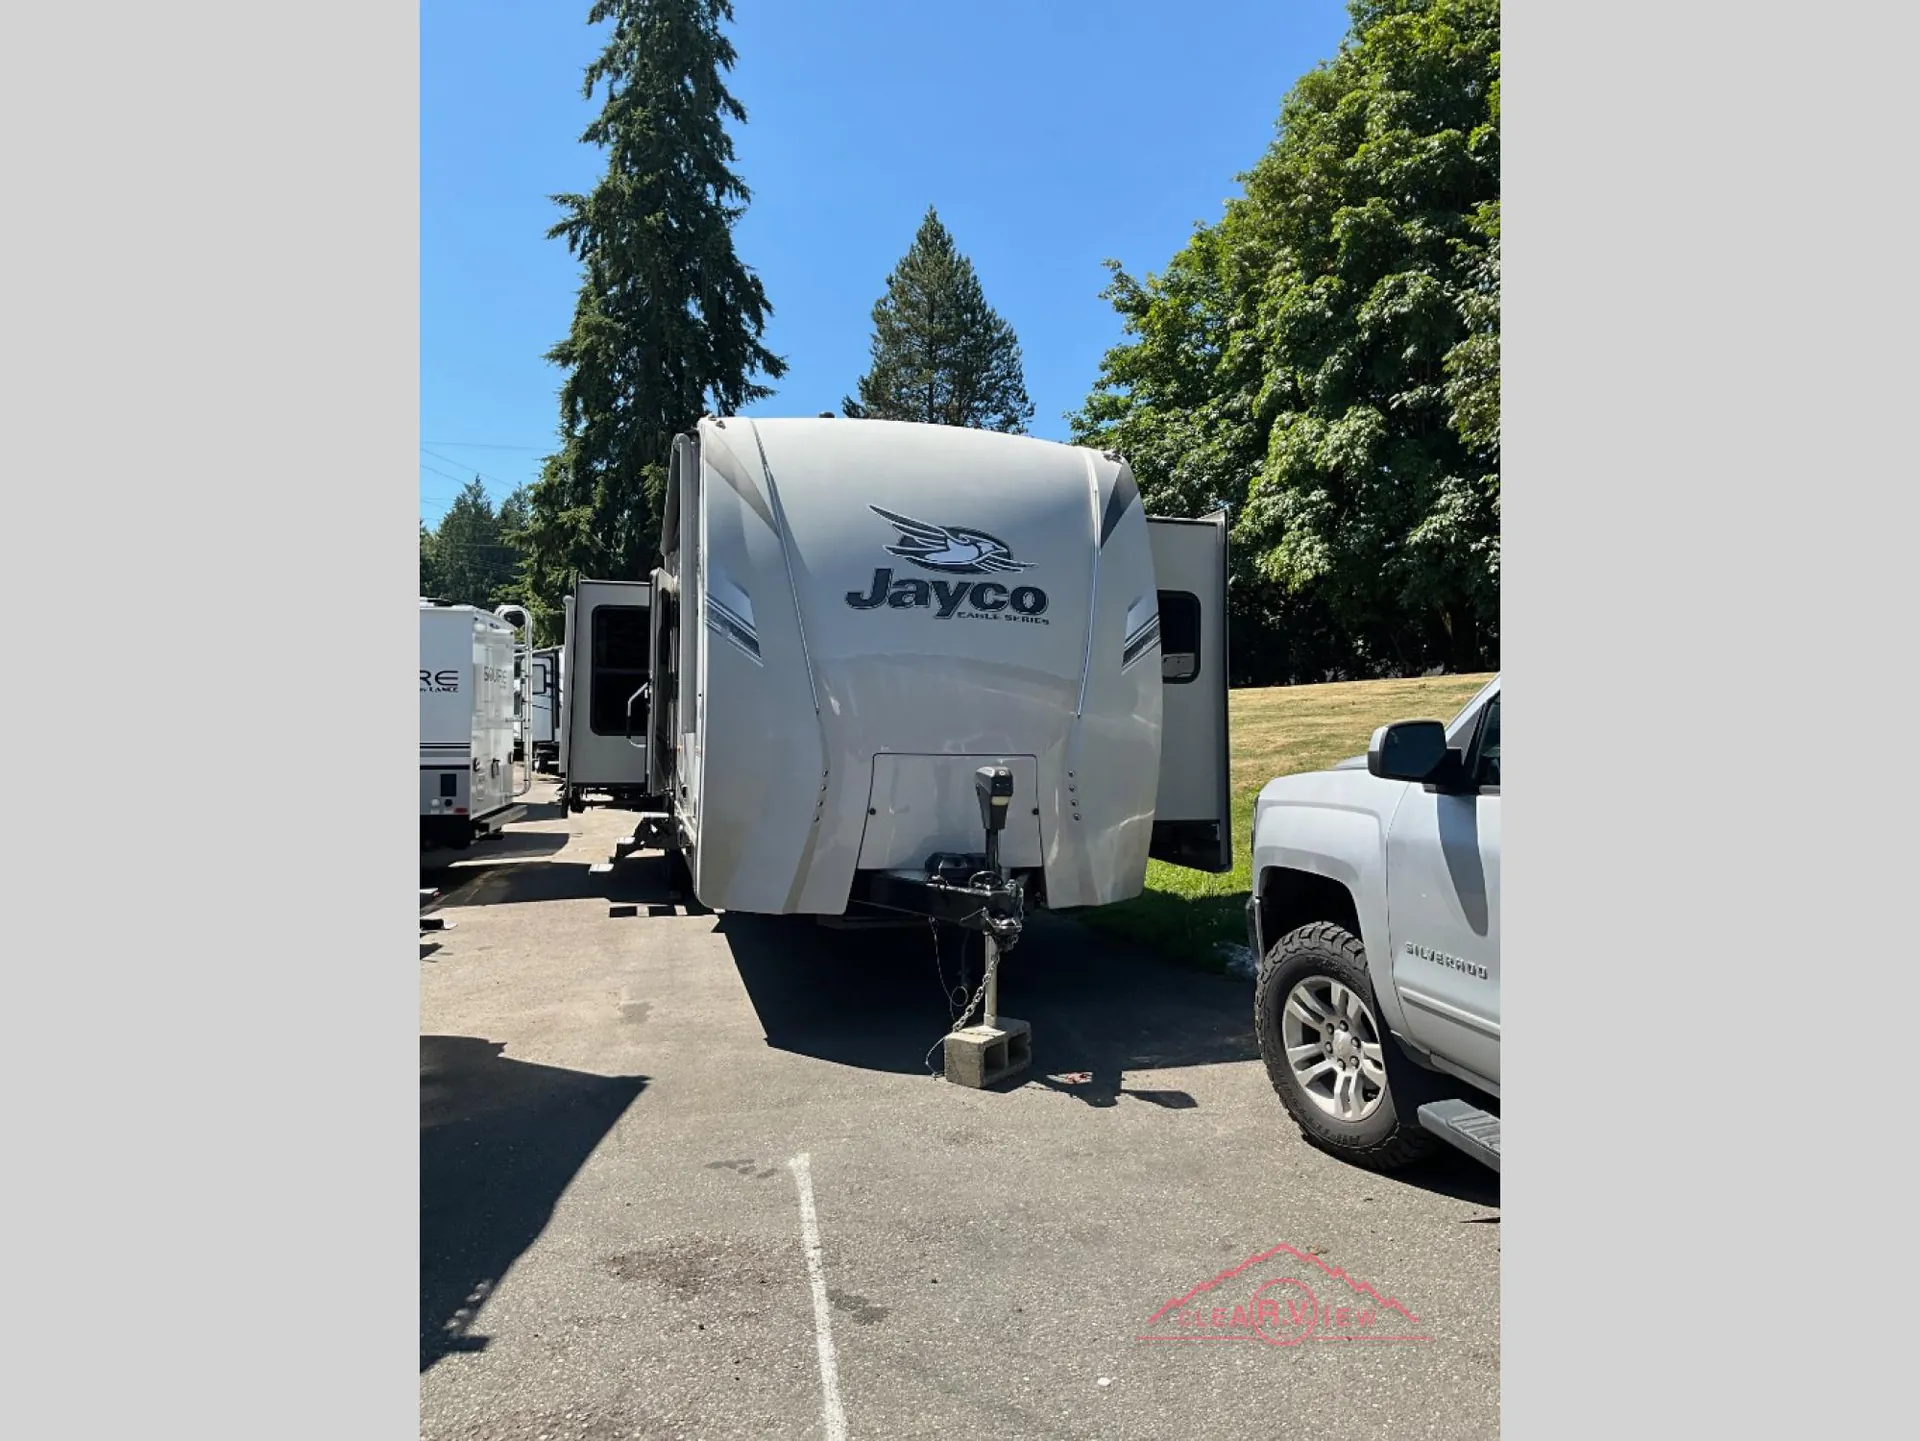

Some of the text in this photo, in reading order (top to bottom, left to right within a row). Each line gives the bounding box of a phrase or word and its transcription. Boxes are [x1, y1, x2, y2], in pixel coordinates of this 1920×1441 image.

[845, 568, 1049, 619] Jayco
[1004, 614, 1050, 625] SERIES
[1405, 941, 1488, 980] SILVERADO
